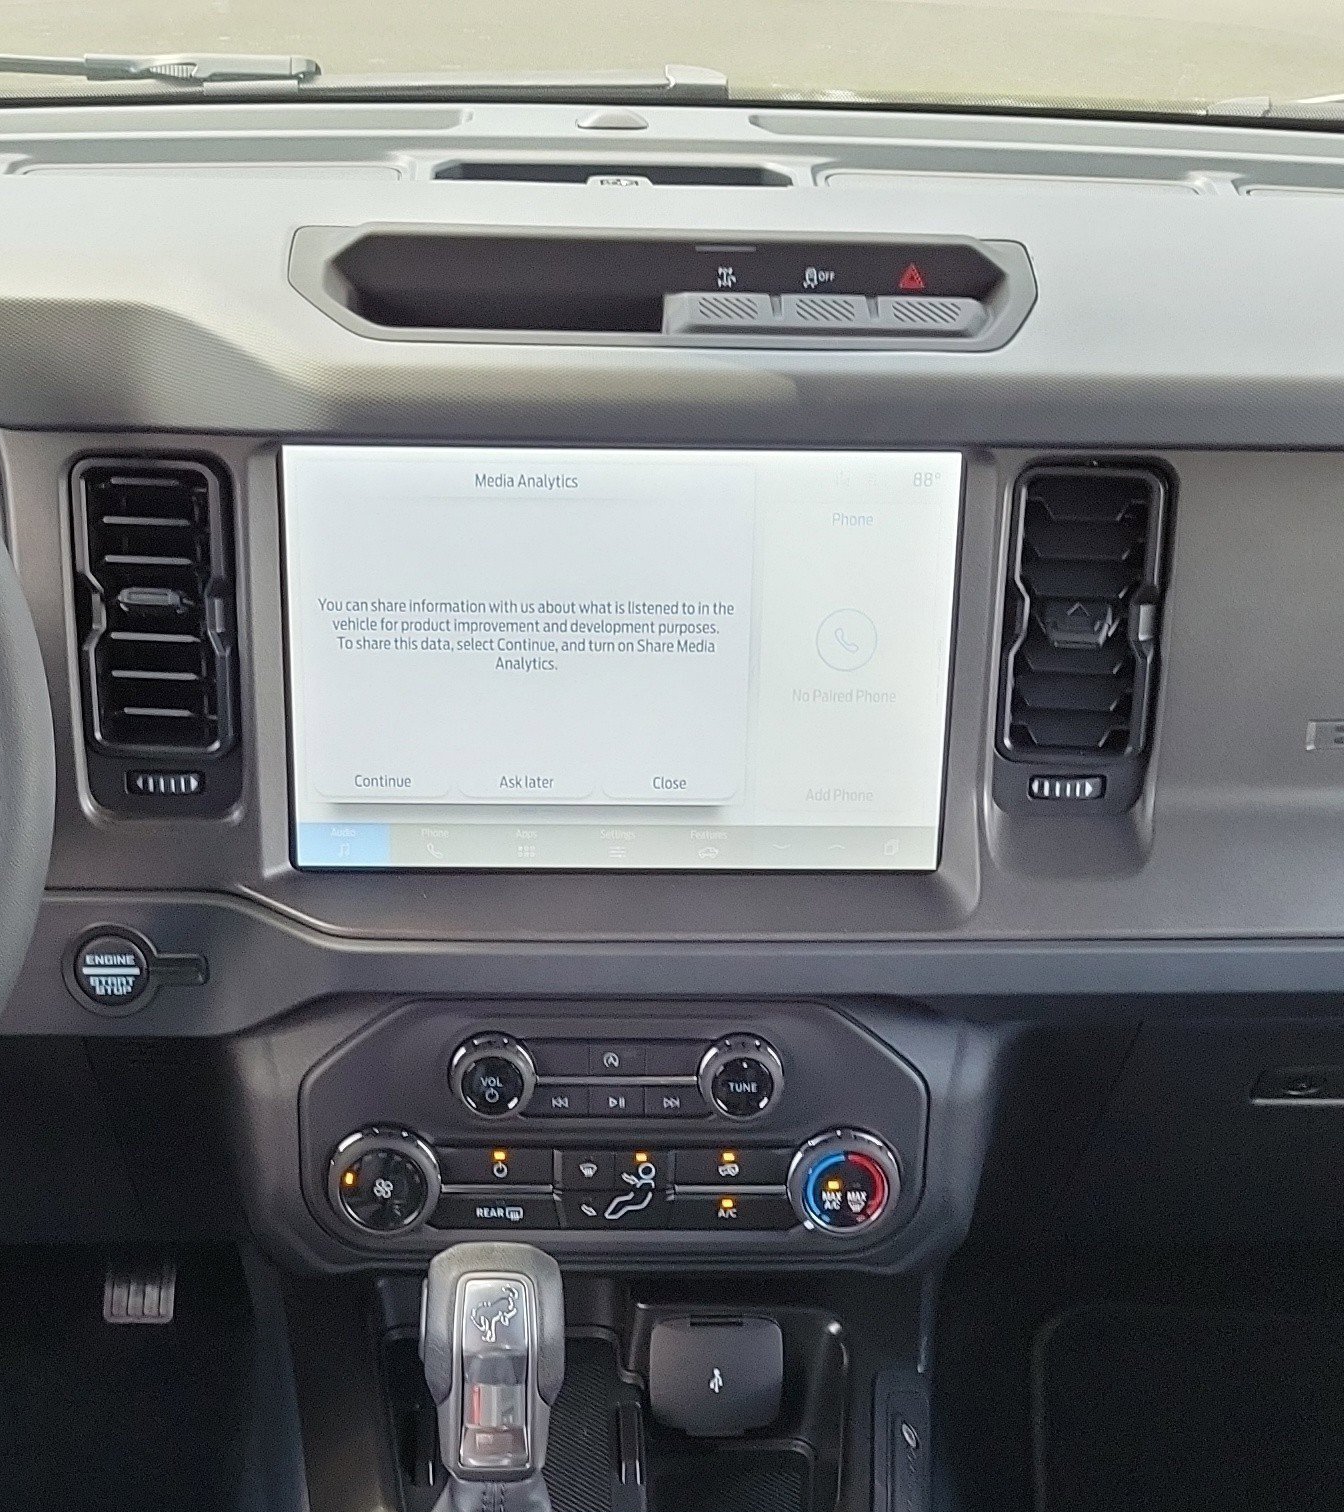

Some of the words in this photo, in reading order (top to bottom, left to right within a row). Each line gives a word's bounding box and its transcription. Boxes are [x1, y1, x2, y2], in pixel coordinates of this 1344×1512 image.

[474, 473, 515, 489] Media
[517, 474, 579, 491] Analytics
[831, 512, 874, 527] Phone
[318, 599, 343, 613] You
[345, 601, 369, 613] can
[371, 599, 407, 613] share
[409, 599, 487, 614] information
[489, 600, 518, 614] with
[520, 602, 535, 614] us
[537, 601, 577, 615] about
[579, 601, 612, 615] what
[615, 601, 626, 615] is
[628, 601, 679, 616] listened
[681, 602, 696, 616] to
[698, 602, 710, 616] in
[713, 602, 735, 616] the
[332, 617, 378, 631] vehicle
[380, 617, 398, 632] for
[401, 618, 451, 634] product
[454, 618, 540, 635] improvement
[543, 620, 568, 633] and
[570, 620, 655, 636] development
[658, 621, 720, 636] purposes.
[337, 636, 354, 650] To
[356, 636, 391, 650] share
[394, 636, 418, 651] this
[421, 637, 454, 653] data,
[456, 637, 494, 651] select
[497, 638, 558, 653] Continue,
[561, 638, 586, 652] and
[588, 639, 614, 652] turn
[618, 641, 635, 652] on
[637, 639, 675, 653] Share
[677, 640, 715, 653] Media
[495, 656, 558, 673] Analytics.
[791, 689, 810, 703] No
[812, 689, 853, 703] Paired
[855, 690, 897, 704] Phone
[354, 774, 412, 789] Continue
[499, 775, 523, 789] Ask
[524, 775, 554, 790] later
[652, 776, 687, 790] Close
[805, 788, 830, 802] Add
[833, 788, 874, 803] Phone
[421, 828, 450, 839] Phone
[85, 954, 136, 966] ENGINE
[479, 1077, 504, 1088] VOL
[727, 1082, 758, 1093] TUNE
[476, 1207, 505, 1219] REAR
[717, 1208, 738, 1219] A/C
